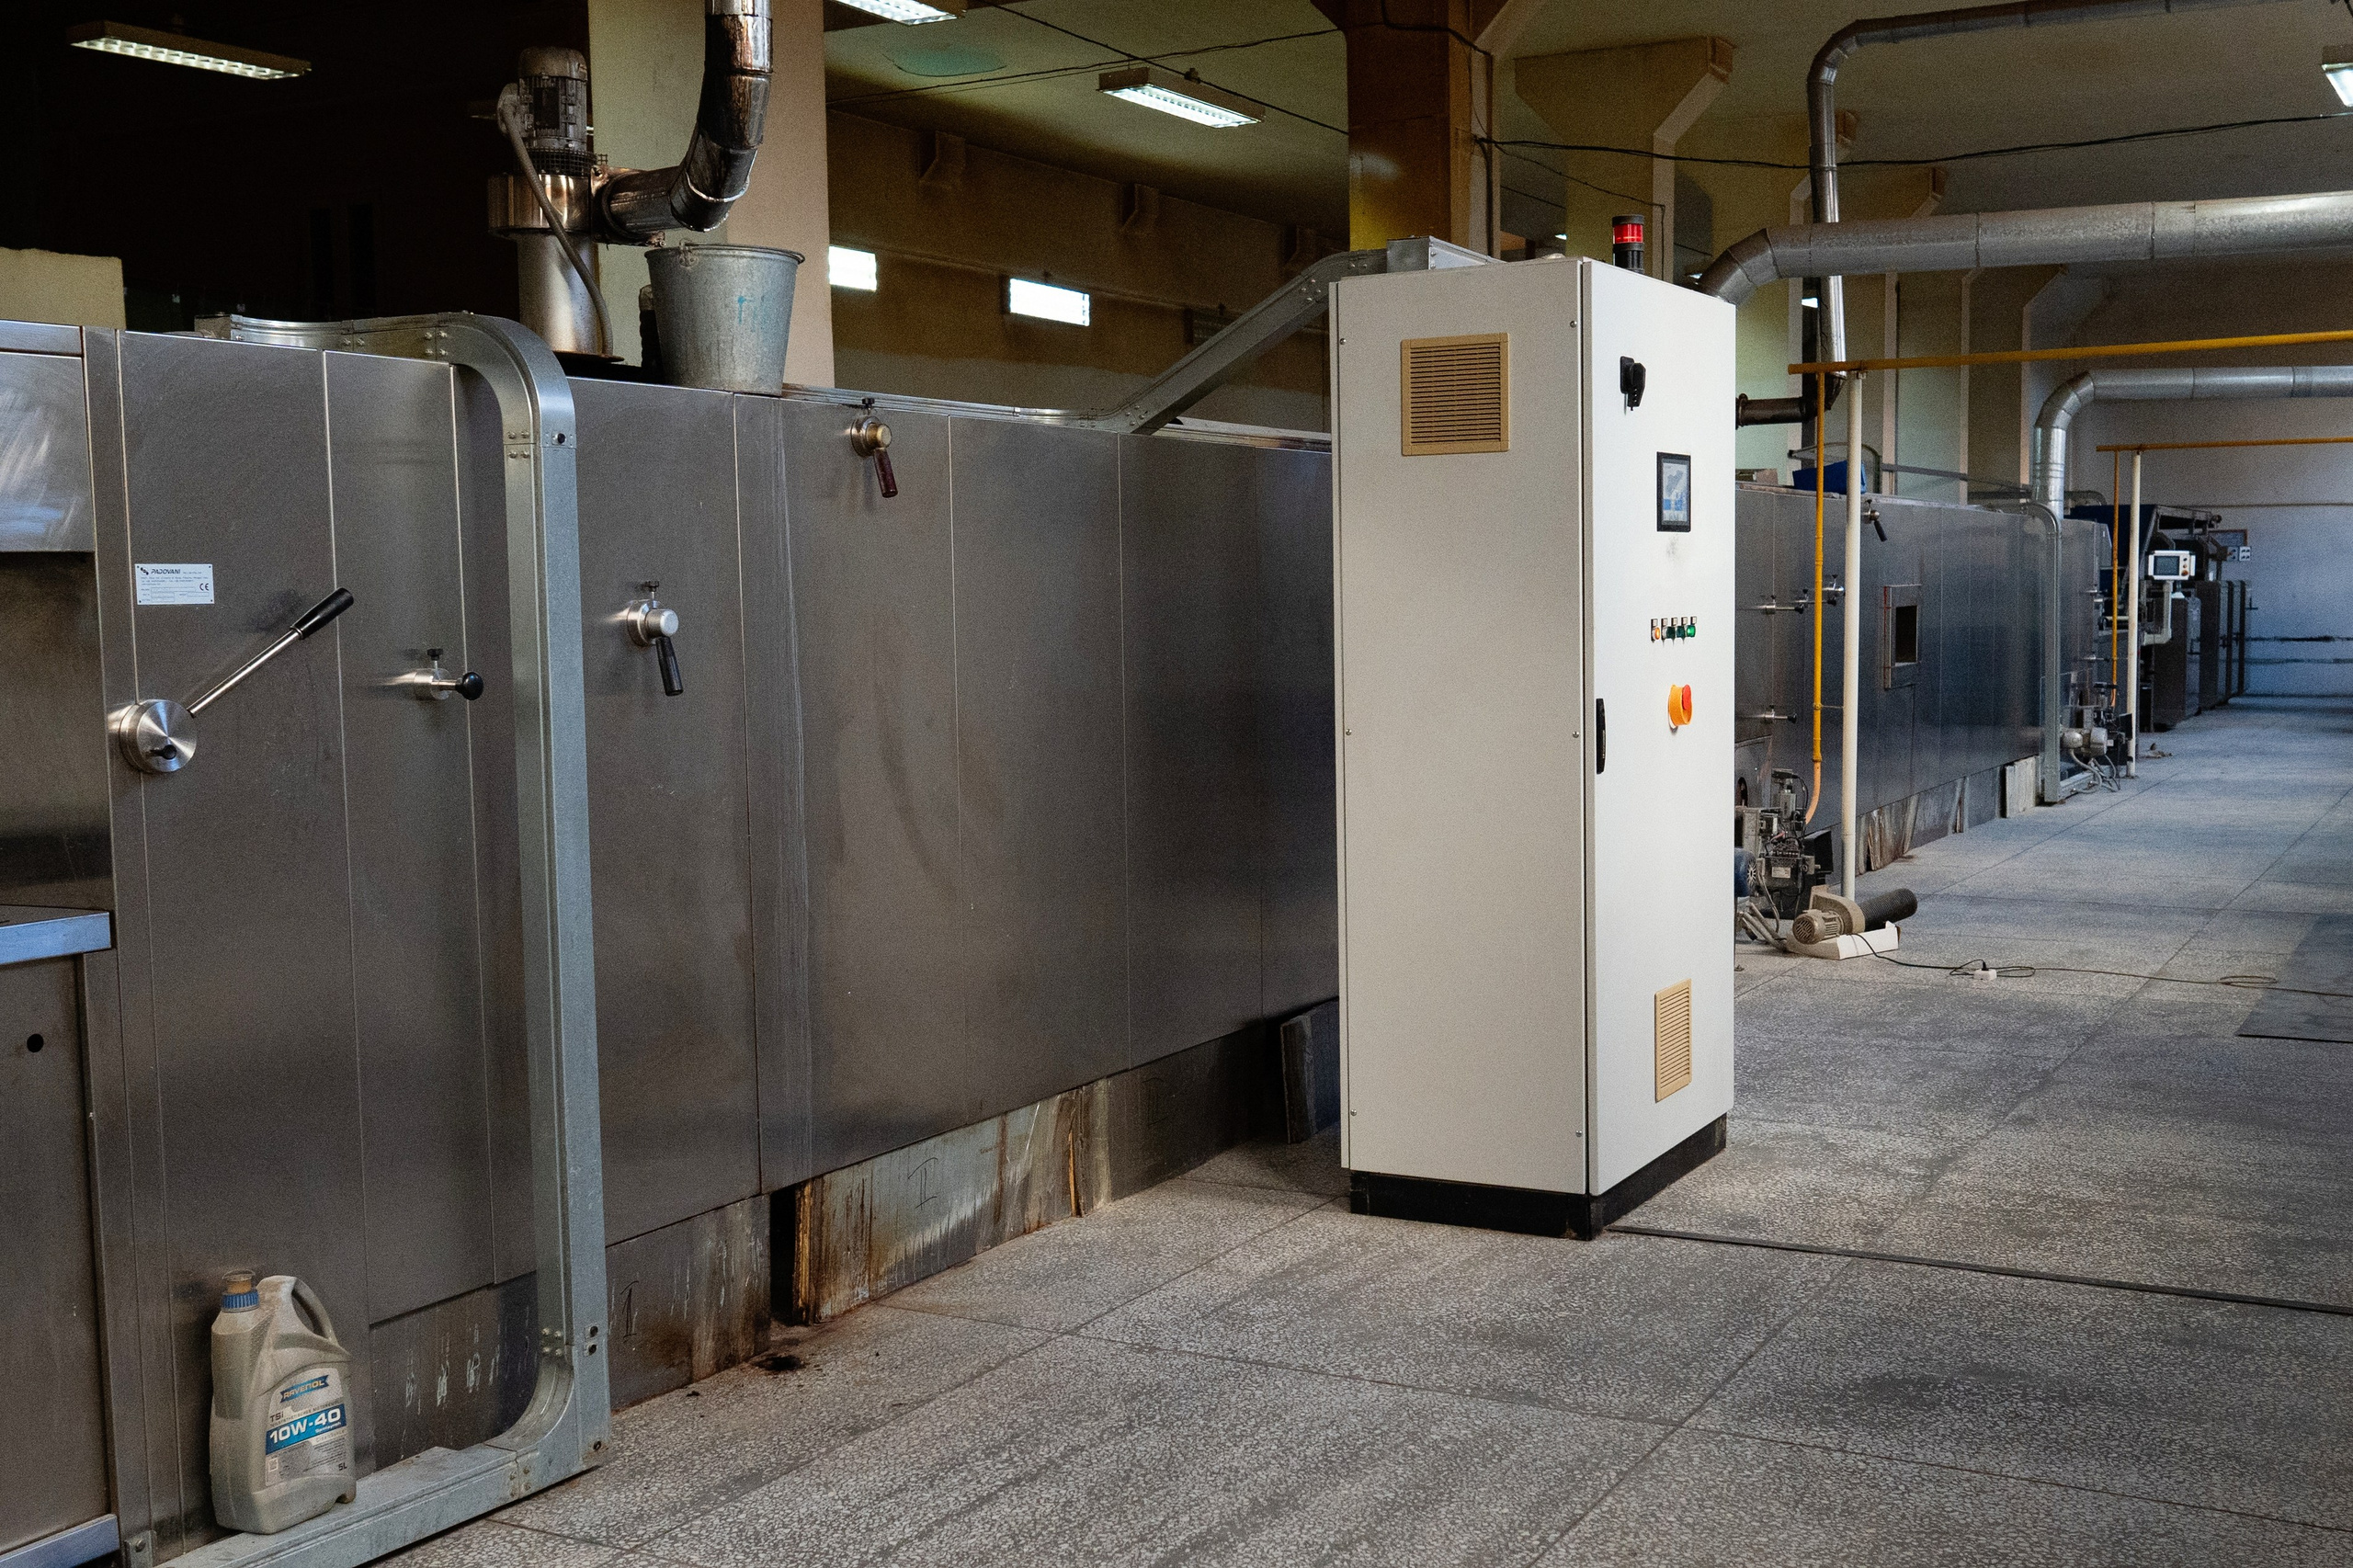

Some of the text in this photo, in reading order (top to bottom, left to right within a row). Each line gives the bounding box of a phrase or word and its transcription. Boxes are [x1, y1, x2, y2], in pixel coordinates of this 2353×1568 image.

[199, 583, 210, 591] CE
[282, 1379, 325, 1399] RAVENOL
[269, 1411, 284, 1423] TSi
[269, 1408, 341, 1444] 10W-40
